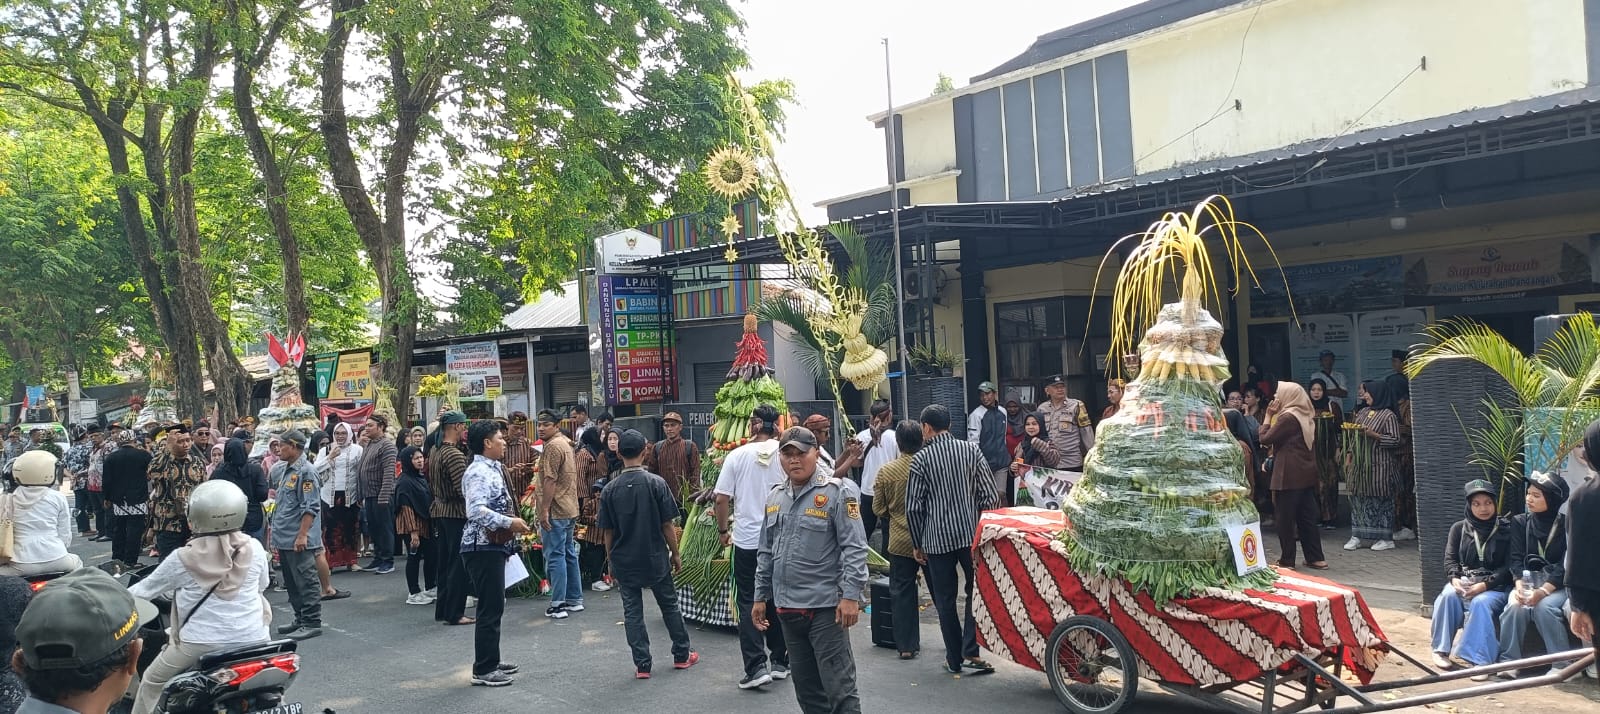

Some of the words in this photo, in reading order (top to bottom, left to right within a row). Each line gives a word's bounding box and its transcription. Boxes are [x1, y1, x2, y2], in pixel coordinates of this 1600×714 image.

[625, 277, 657, 287] LPMK
[602, 282, 611, 328] DANDANGAN
[630, 297, 667, 307] BABINA
[605, 332, 613, 358] DAMAI
[113, 609, 139, 641] LINMAS
[283, 702, 302, 714] YBP
